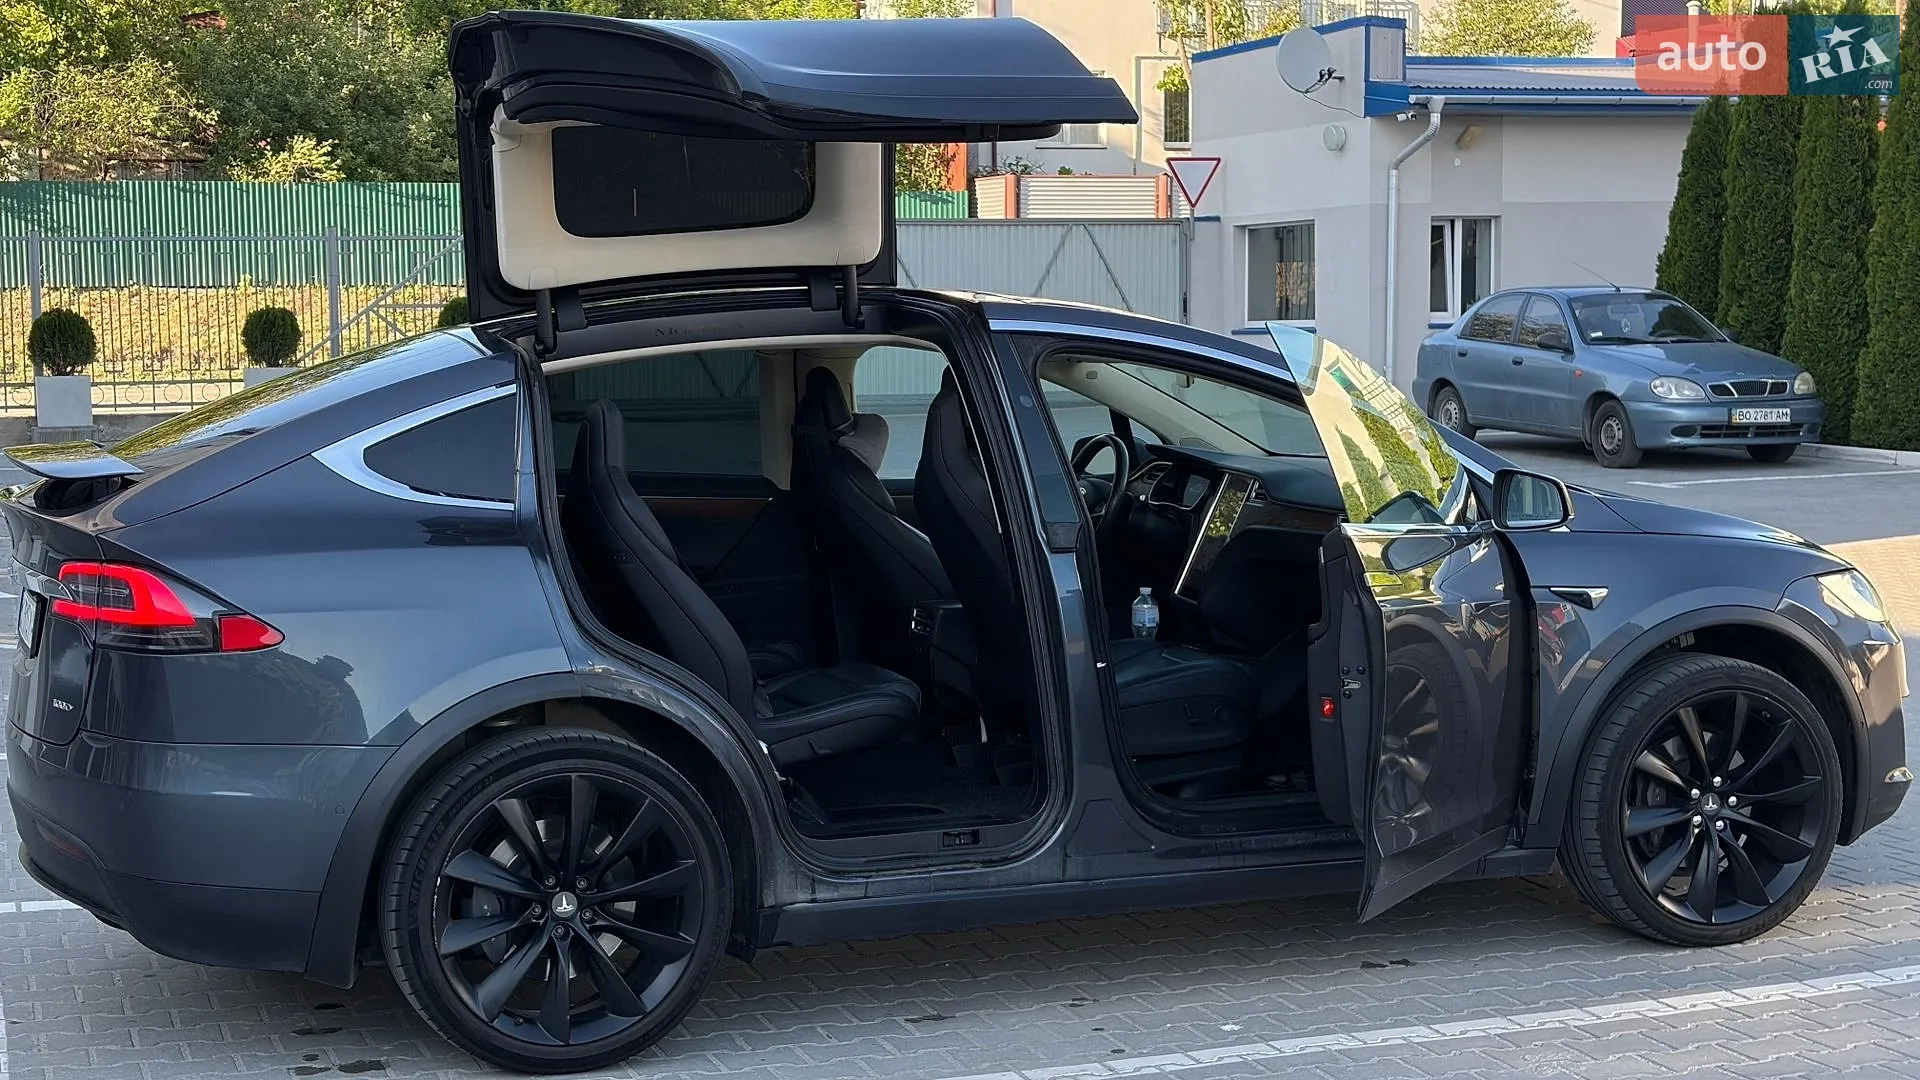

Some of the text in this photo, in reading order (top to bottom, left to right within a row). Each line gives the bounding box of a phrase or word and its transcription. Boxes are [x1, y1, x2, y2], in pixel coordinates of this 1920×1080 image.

[1738, 410, 1788, 421] BO 2781 AM
